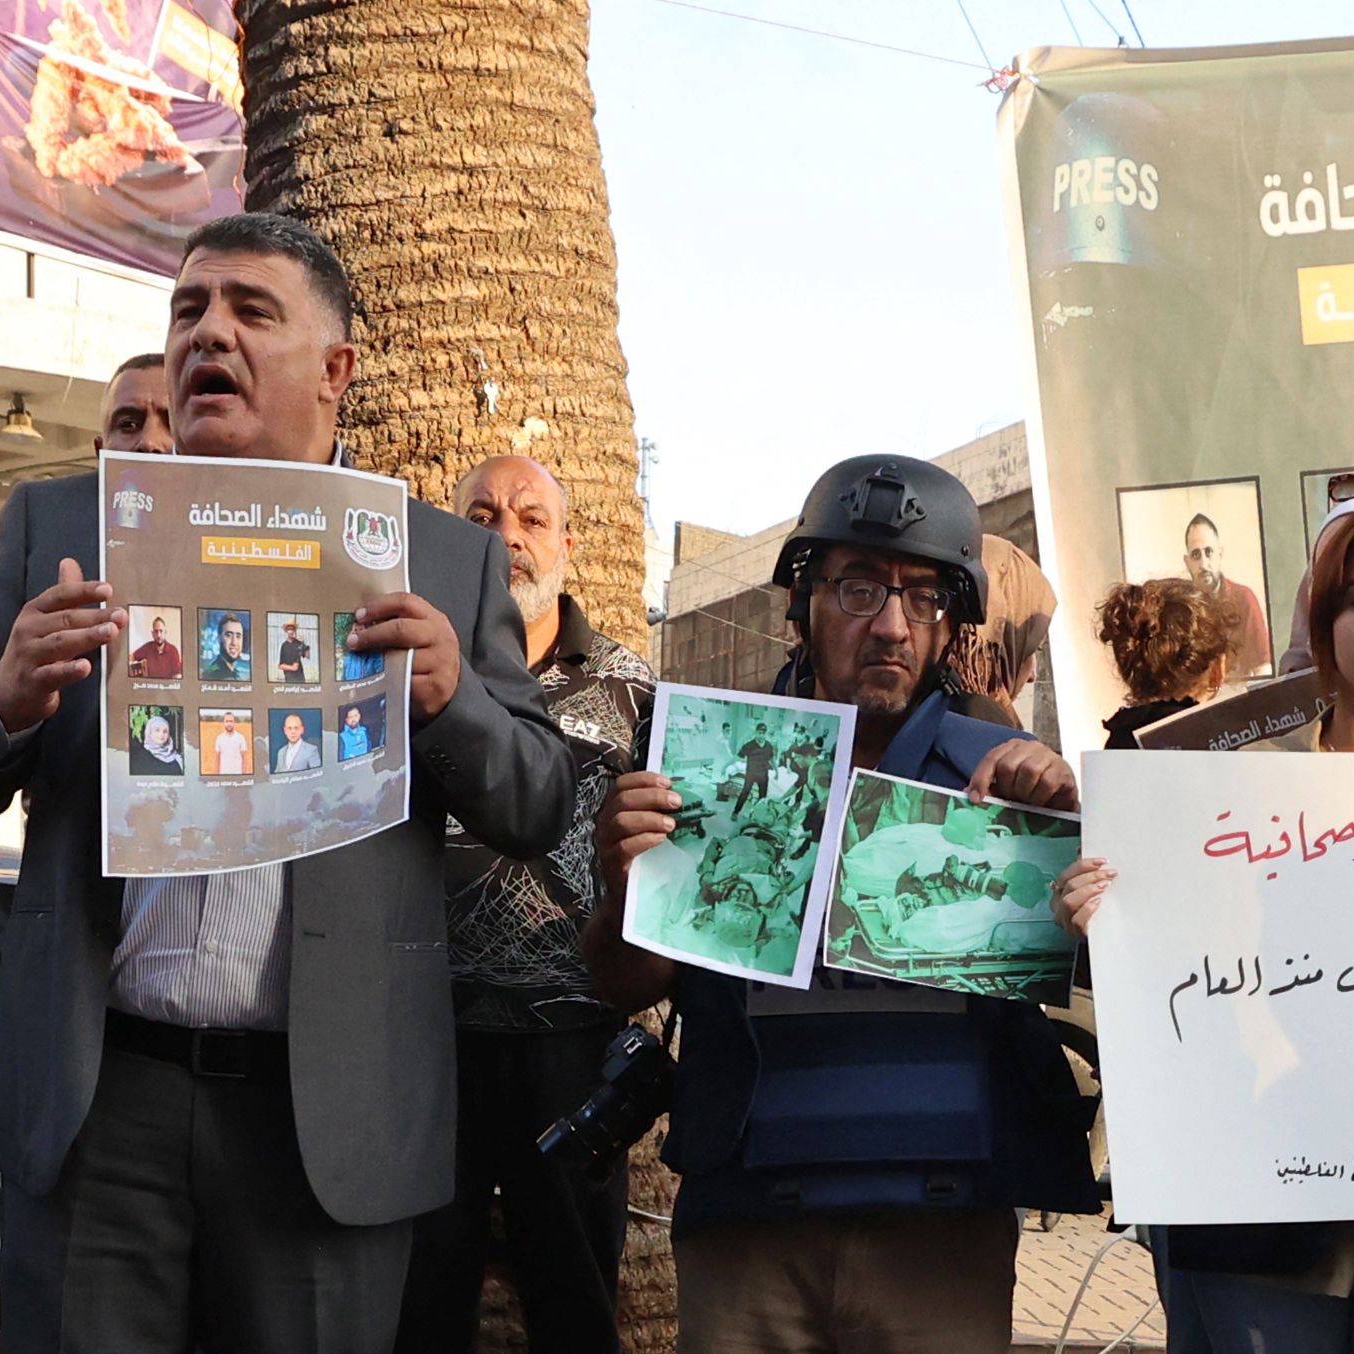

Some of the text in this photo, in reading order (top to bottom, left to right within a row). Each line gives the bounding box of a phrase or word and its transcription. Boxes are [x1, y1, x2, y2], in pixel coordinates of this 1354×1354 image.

[1053, 156, 1159, 213] PRESS
[113, 490, 154, 513] PRESS
[188, 502, 327, 531] شهداء الصحافة
[207, 541, 313, 562] الفلسطينية
[559, 714, 601, 738] EA7
[1264, 706, 1307, 734] شهداء
[1269, 954, 1325, 998] منذ
[1169, 954, 1264, 1043] العام
